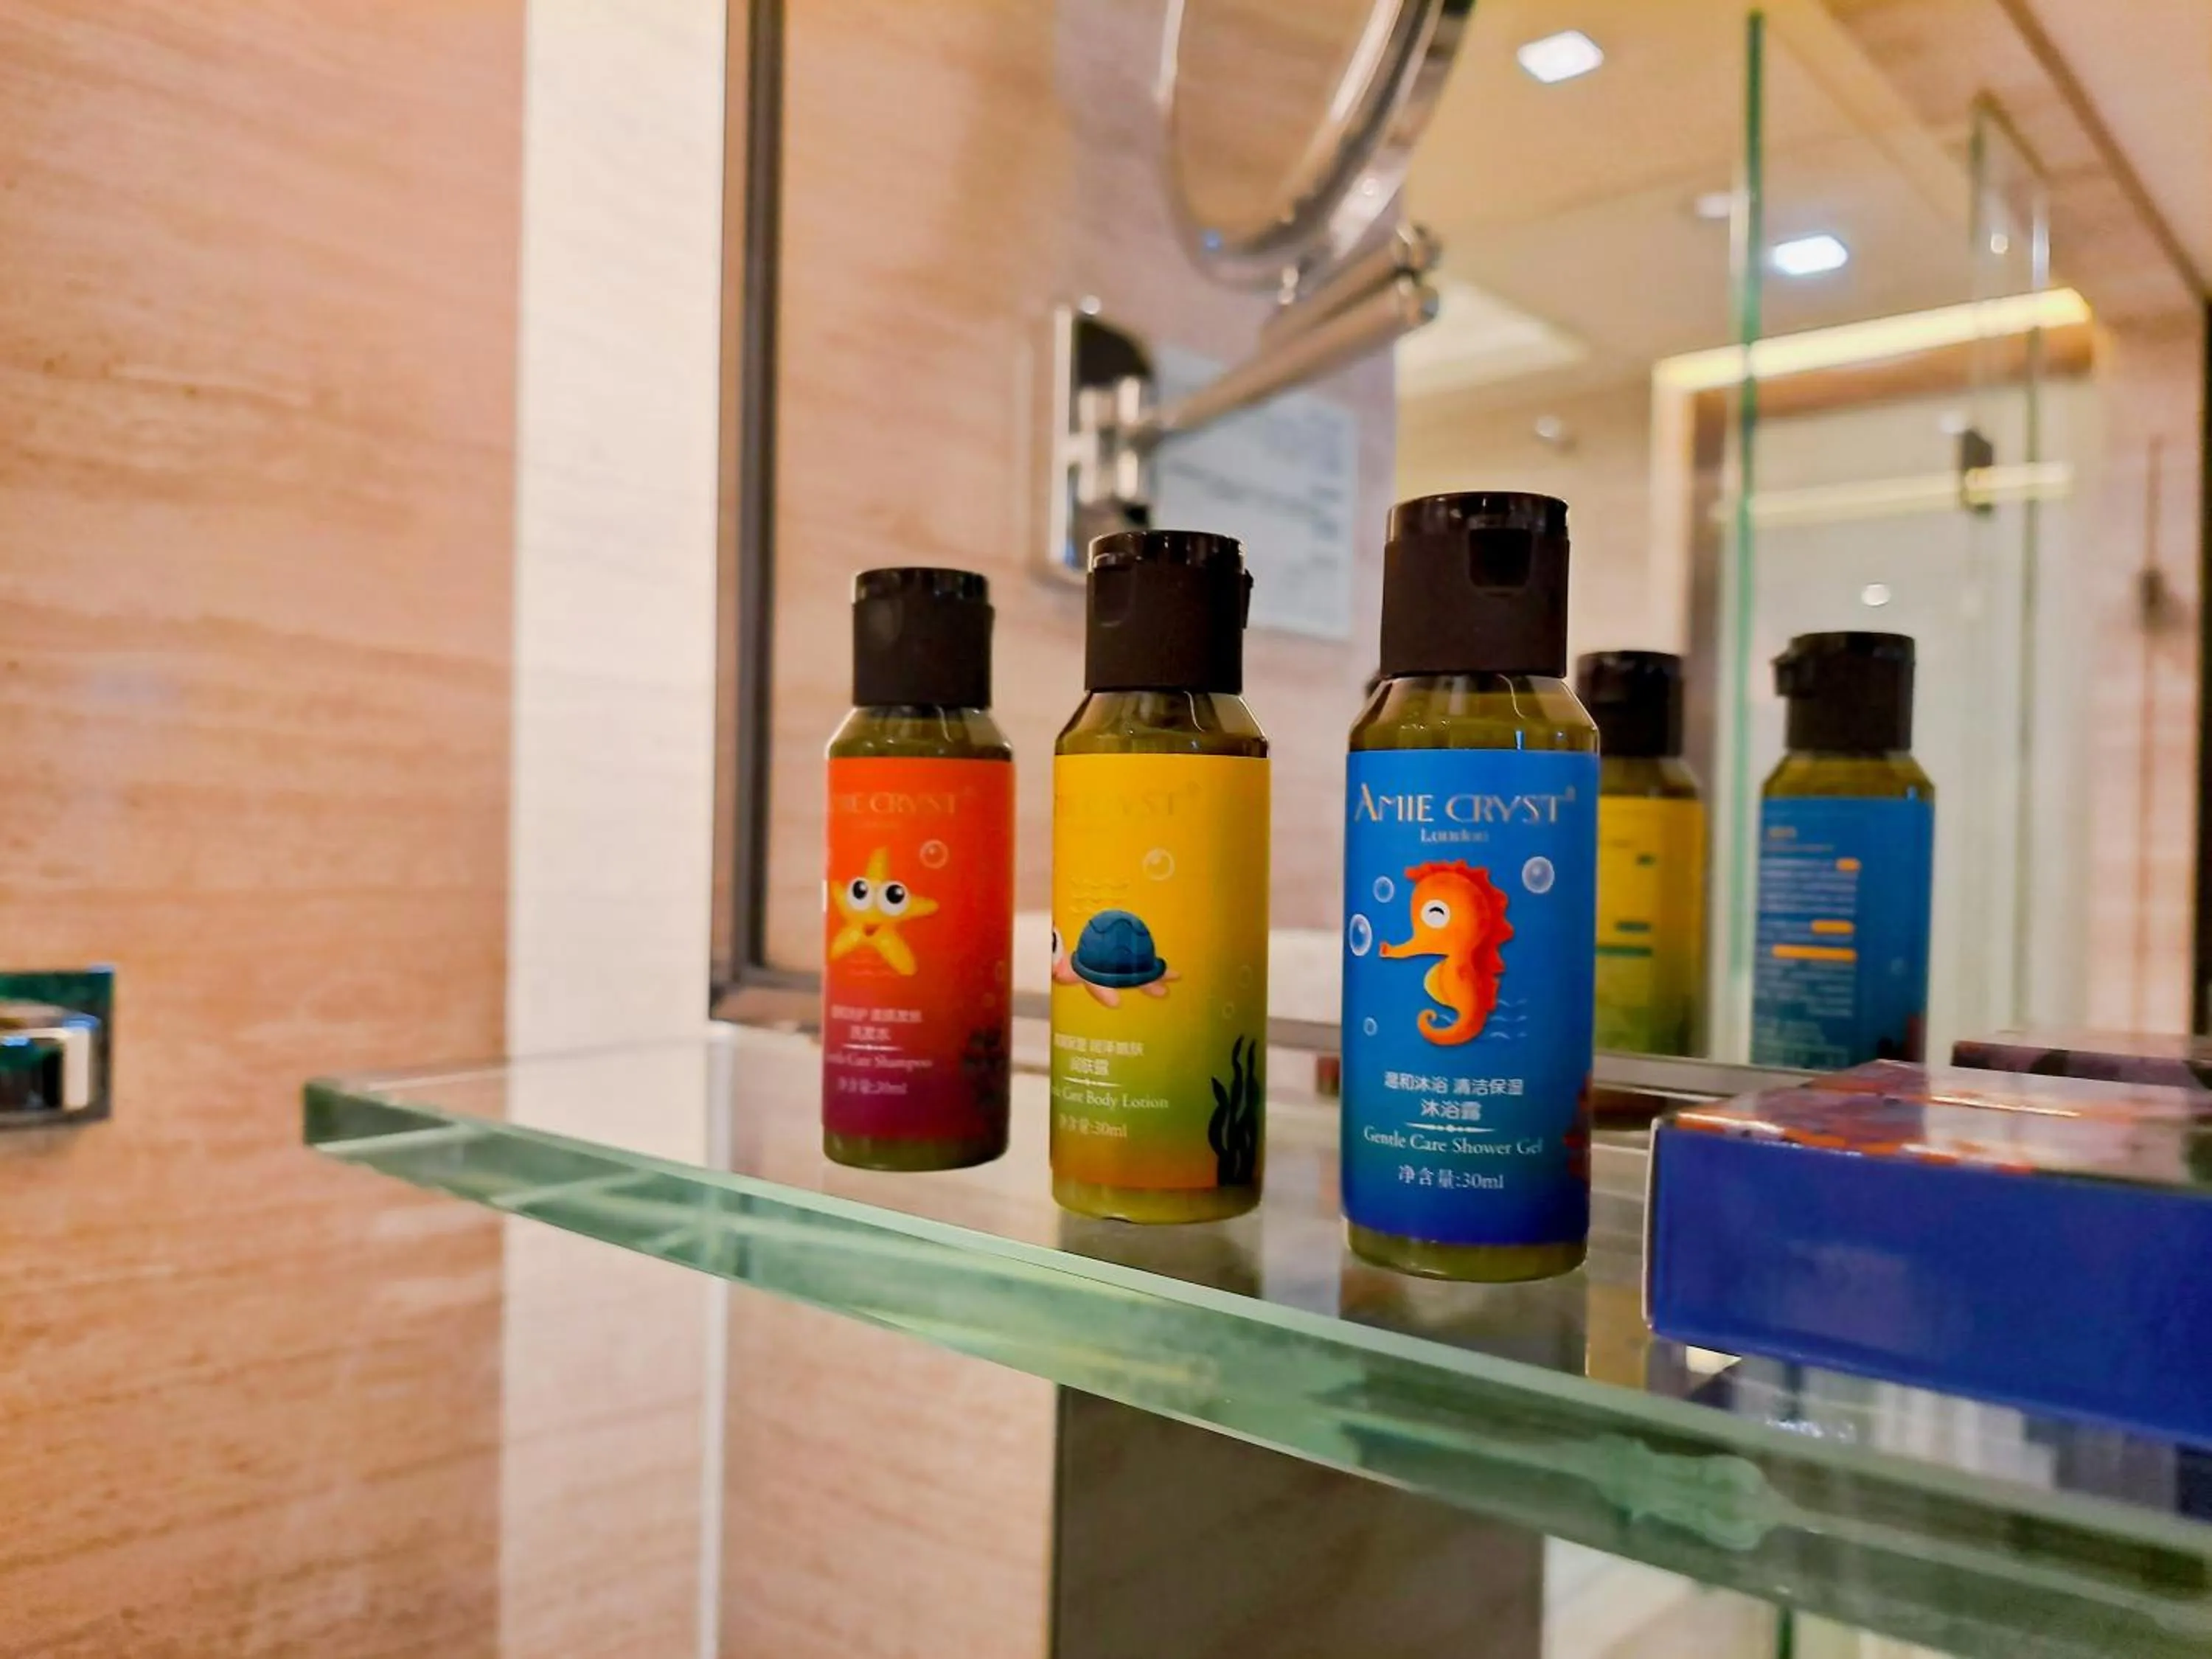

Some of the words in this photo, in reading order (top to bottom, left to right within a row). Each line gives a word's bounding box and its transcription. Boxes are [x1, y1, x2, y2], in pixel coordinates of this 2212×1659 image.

[1354, 782, 1435, 822] AMIE
[1445, 793, 1559, 824] CRYST
[1085, 1089, 1119, 1111] Body
[1121, 1092, 1169, 1110] Lotion
[1420, 1098, 1482, 1121] 沐浴露
[1363, 1124, 1407, 1150] Gentle
[1409, 1133, 1447, 1152] Care
[1452, 1134, 1512, 1156] Shower
[1516, 1137, 1544, 1155] Gel
